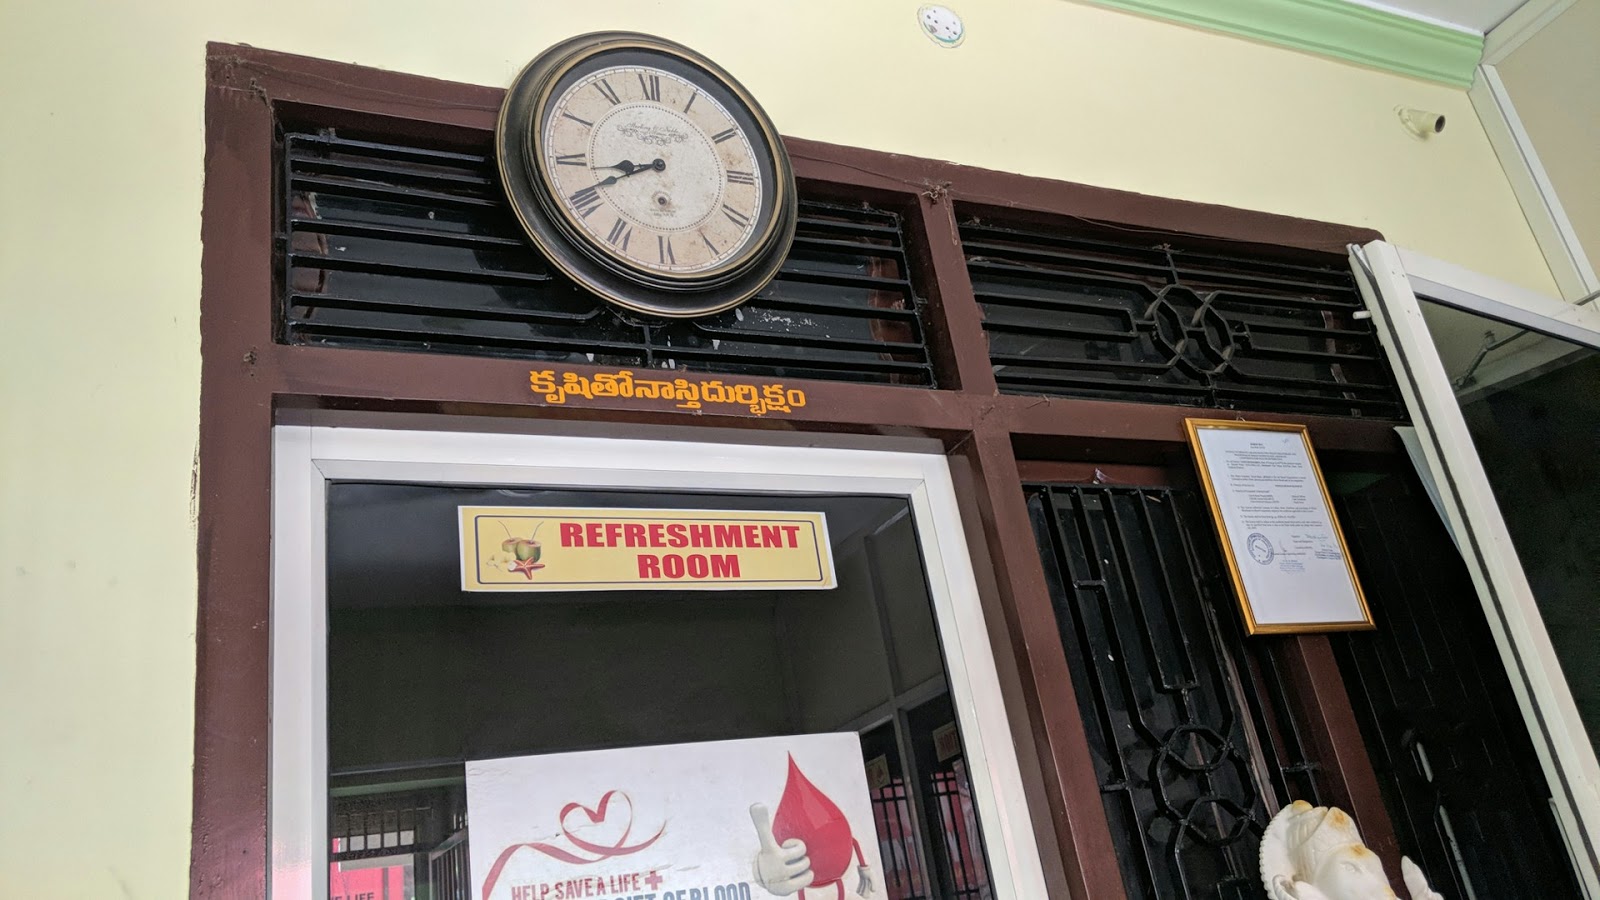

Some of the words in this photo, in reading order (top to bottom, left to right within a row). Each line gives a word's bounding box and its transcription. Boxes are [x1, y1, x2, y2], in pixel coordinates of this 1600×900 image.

[726, 169, 754, 185] III
[559, 522, 800, 548] REFRESHMENT
[637, 554, 741, 579] ROOM
[511, 883, 550, 900] HELP
[555, 878, 594, 900] SAVE
[597, 876, 606, 896] A
[610, 873, 641, 894] LIFE
